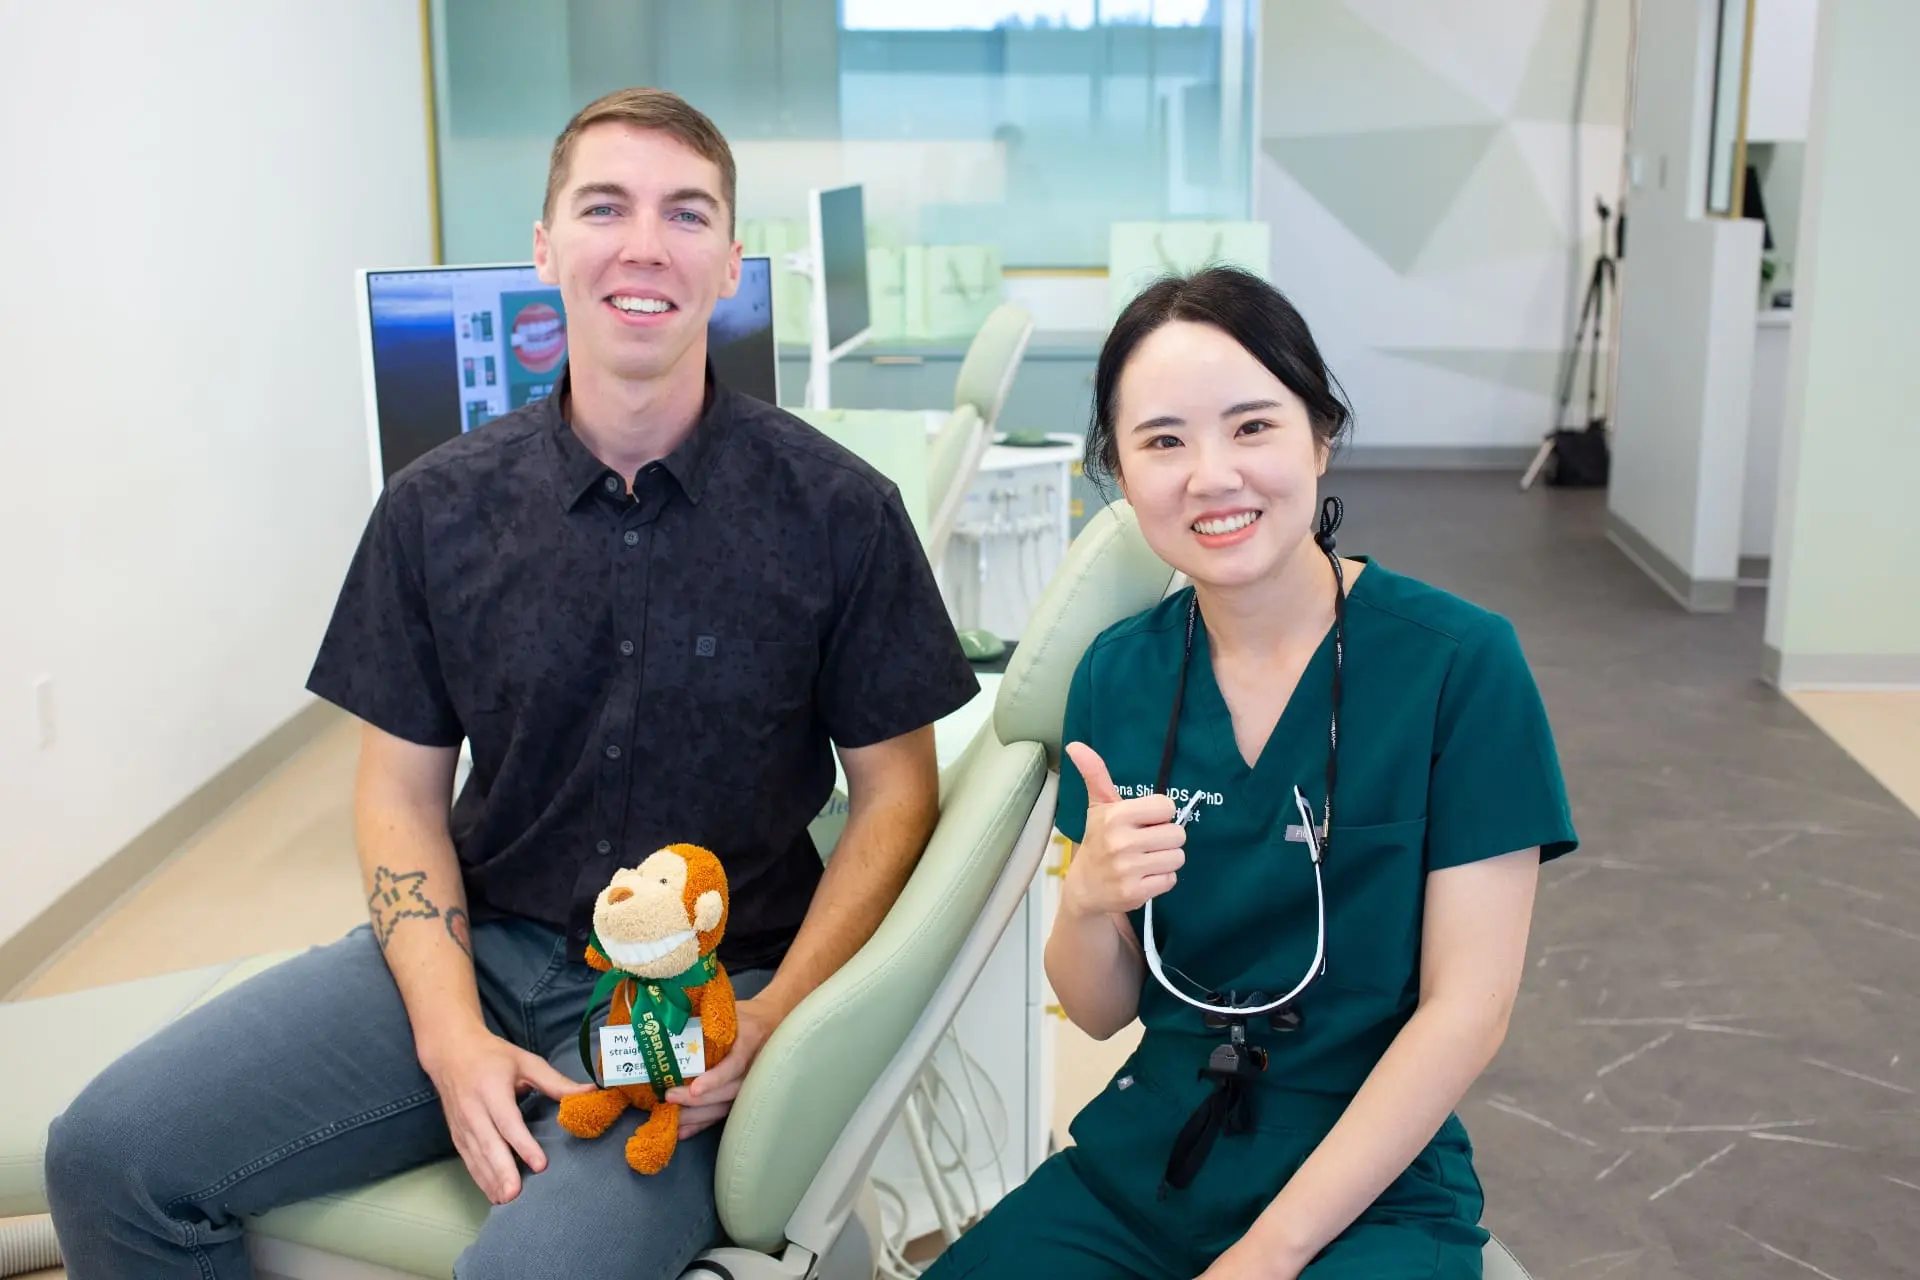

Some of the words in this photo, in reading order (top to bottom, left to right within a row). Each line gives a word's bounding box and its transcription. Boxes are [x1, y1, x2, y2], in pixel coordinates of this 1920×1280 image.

[614, 1035, 629, 1043] My
[609, 1047, 641, 1056] straig
[678, 1056, 691, 1065] TY
